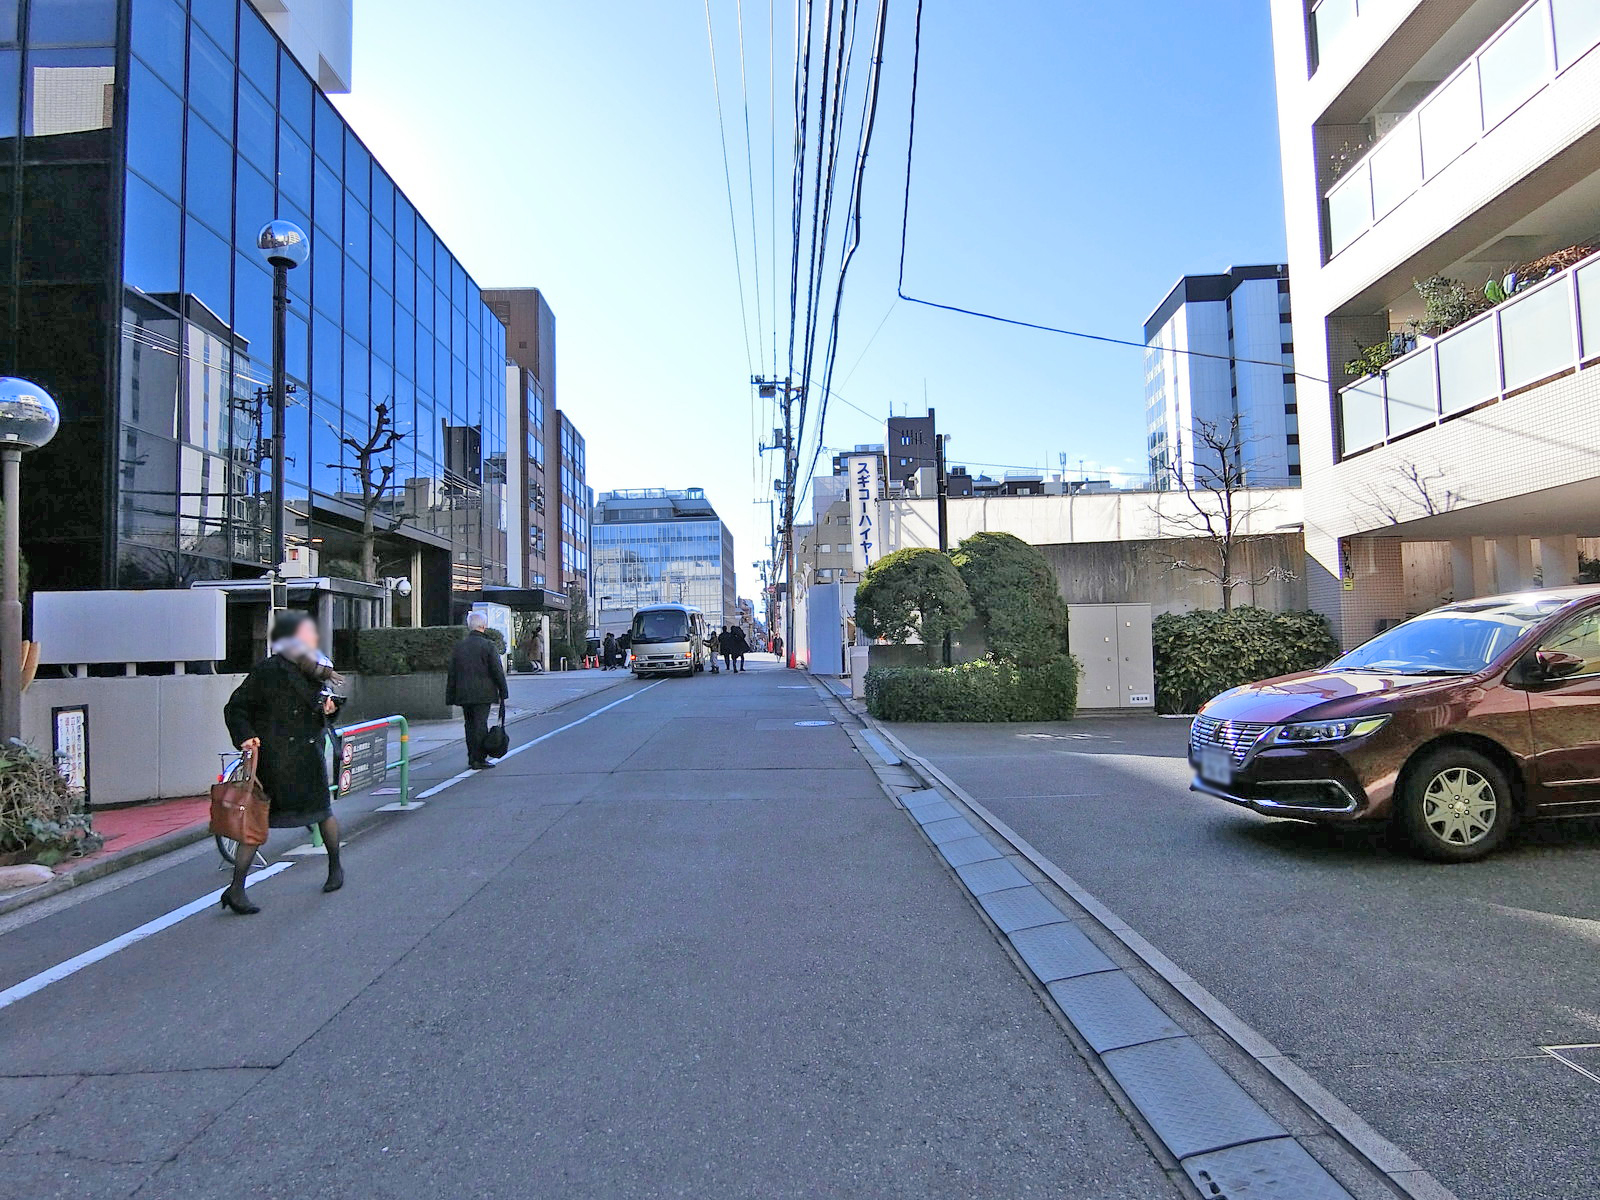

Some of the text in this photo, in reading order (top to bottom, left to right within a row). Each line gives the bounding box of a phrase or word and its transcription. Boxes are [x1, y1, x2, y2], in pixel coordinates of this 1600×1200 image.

[857, 462, 873, 565] スギコーハイヤー
